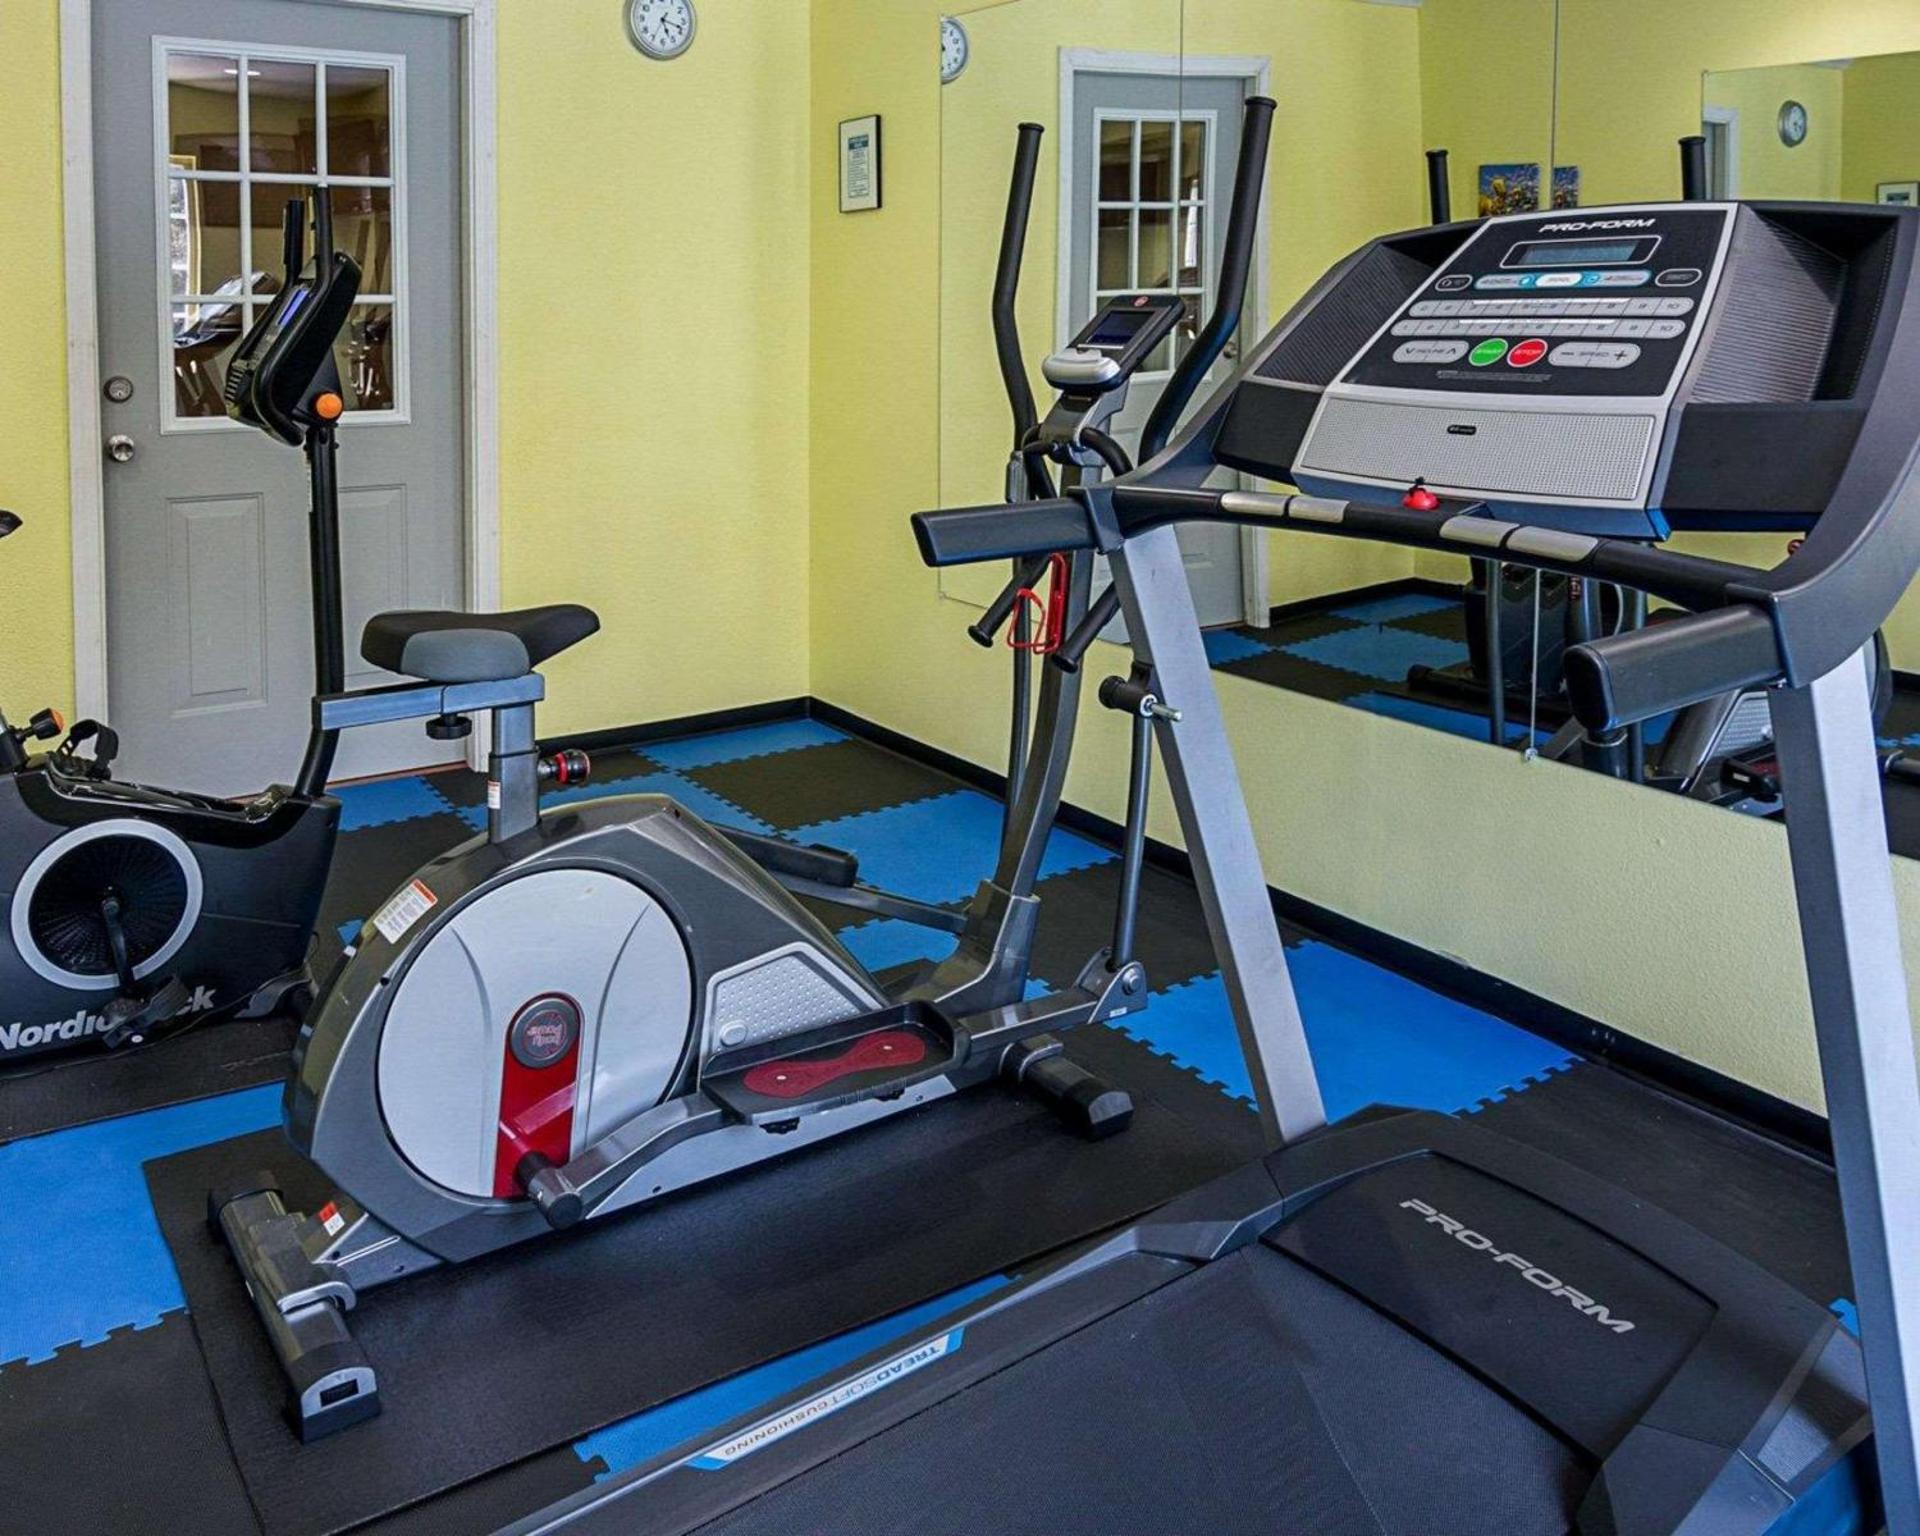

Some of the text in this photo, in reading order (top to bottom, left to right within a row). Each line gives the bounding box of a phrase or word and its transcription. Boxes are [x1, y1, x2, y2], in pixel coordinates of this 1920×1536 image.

[1539, 218, 1656, 233] PRO-FORM
[0, 985, 216, 1050] Nordick
[1399, 1198, 1636, 1333] PRO-FORM
[725, 1401, 829, 1456] CUSHIONING
